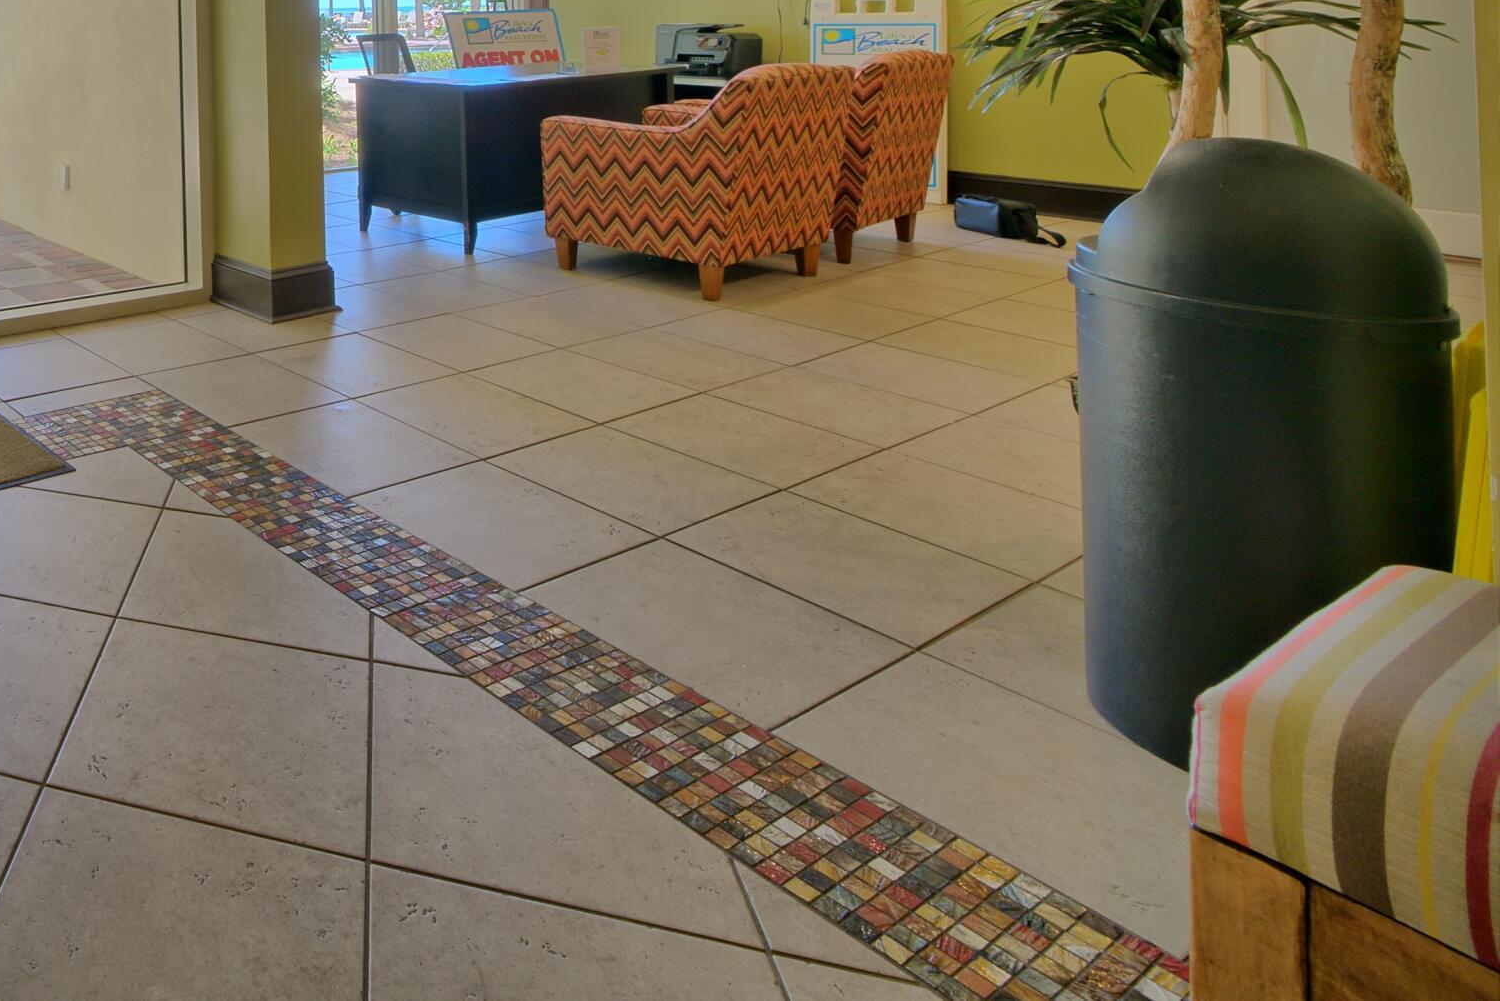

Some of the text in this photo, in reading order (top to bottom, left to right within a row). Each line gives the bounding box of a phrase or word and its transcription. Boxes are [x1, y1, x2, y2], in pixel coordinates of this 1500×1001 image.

[491, 19, 543, 41] Beach
[857, 31, 930, 52] Beach
[462, 49, 560, 68] AGENT ON
